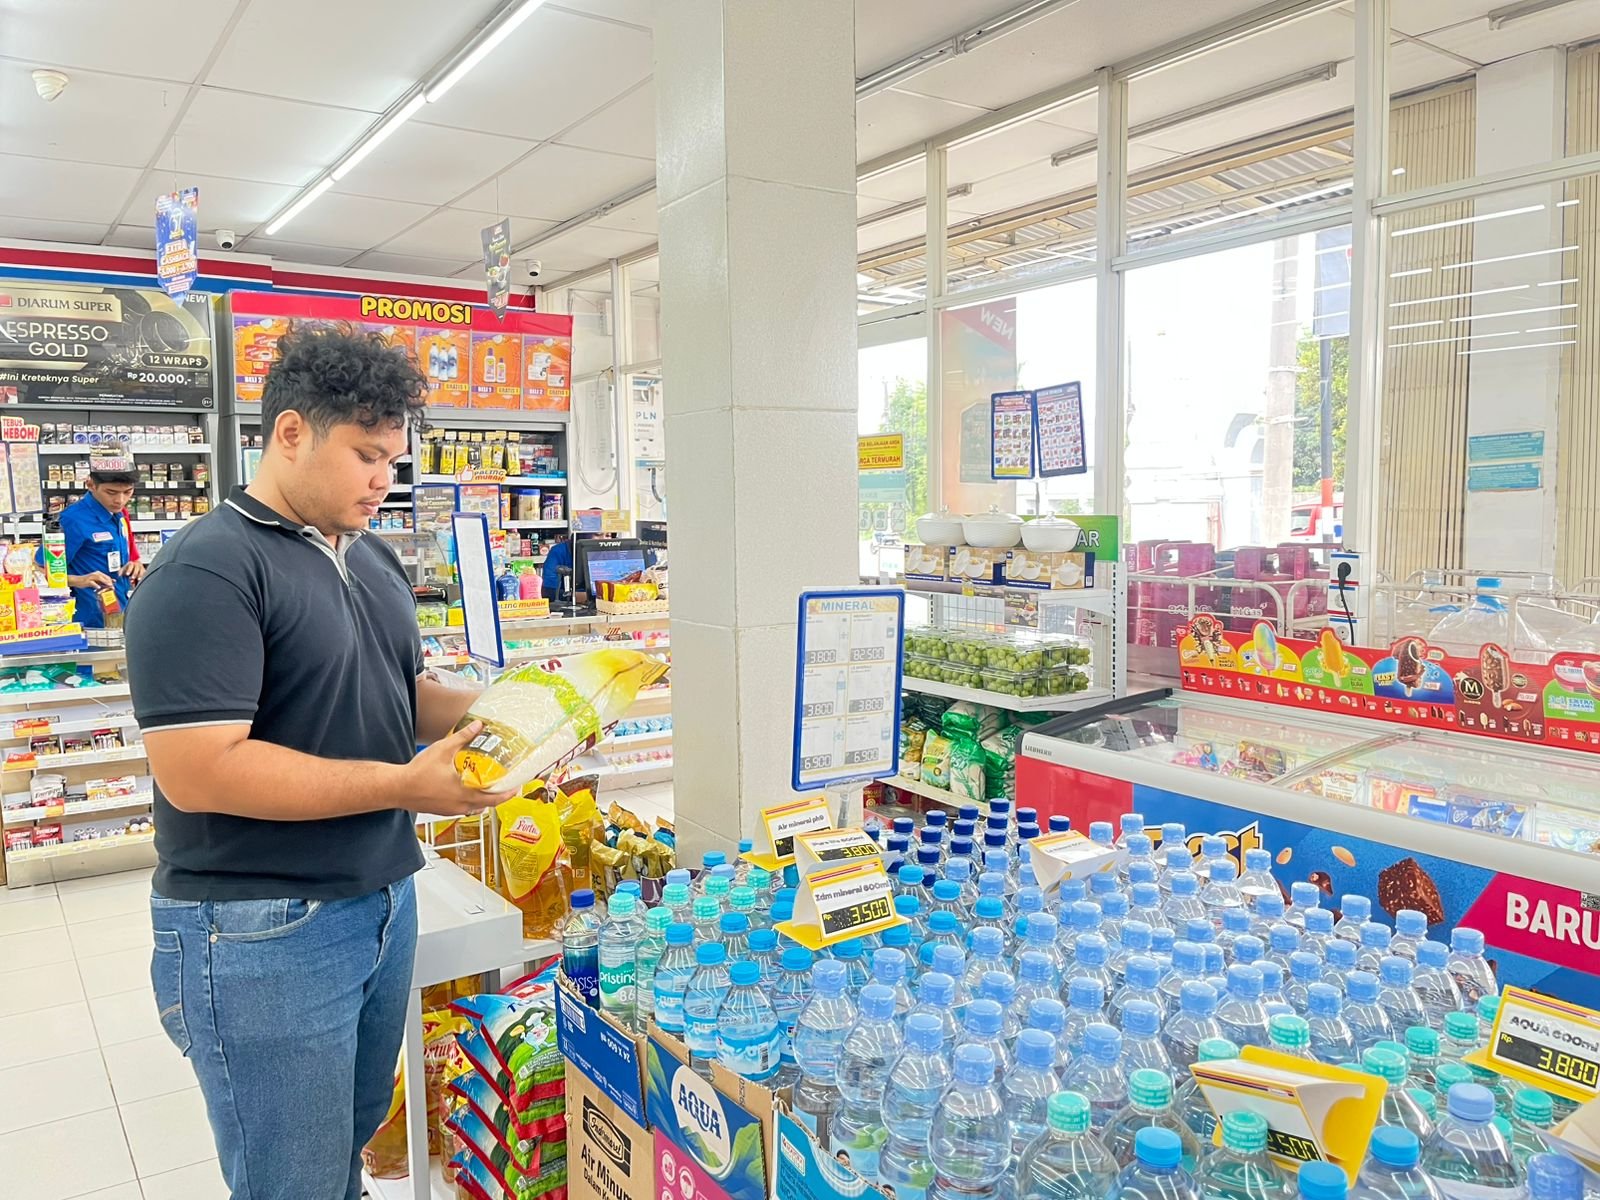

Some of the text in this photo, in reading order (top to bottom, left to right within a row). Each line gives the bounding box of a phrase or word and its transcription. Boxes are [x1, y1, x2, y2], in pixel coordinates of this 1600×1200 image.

[18, 297, 113, 312] DJARUM SUPER
[360, 296, 471, 325] PROMOSI
[6, 321, 109, 342] ESPRESSO
[29, 342, 89, 358] GOLD
[149, 355, 202, 366] 12 WRAPS
[21, 374, 69, 384] Kreteknya
[72, 375, 99, 384] Super
[127, 372, 192, 385] Rp 20.000,-
[3, 418, 23, 427] TEBUS
[636, 411, 657, 420] PLN
[3, 427, 39, 440] HEBOH!
[1076, 529, 1100, 547] AR
[518, 601, 546, 609] MURAH
[821, 600, 875, 611] MINERAL
[18, 629, 53, 639] HEBOH!
[810, 650, 836, 664] 3.800
[808, 702, 833, 716] 3.800
[859, 698, 883, 712] 3.800
[805, 755, 831, 769] 6.900
[854, 749, 878, 763] 6.900
[789, 817, 812, 828] mineral
[841, 844, 877, 857] 3.800
[815, 881, 889, 901] Idm mineral 600ml
[851, 899, 889, 925] 3.500
[1510, 1016, 1549, 1038] AQUA
[1501, 1033, 1514, 1044] Rp.
[1538, 1047, 1599, 1086] 3.800
[678, 1083, 722, 1140] AQUA
[591, 1117, 621, 1155] Indomaret
[581, 1143, 595, 1171] Air
[583, 1167, 601, 1196] Dalam
